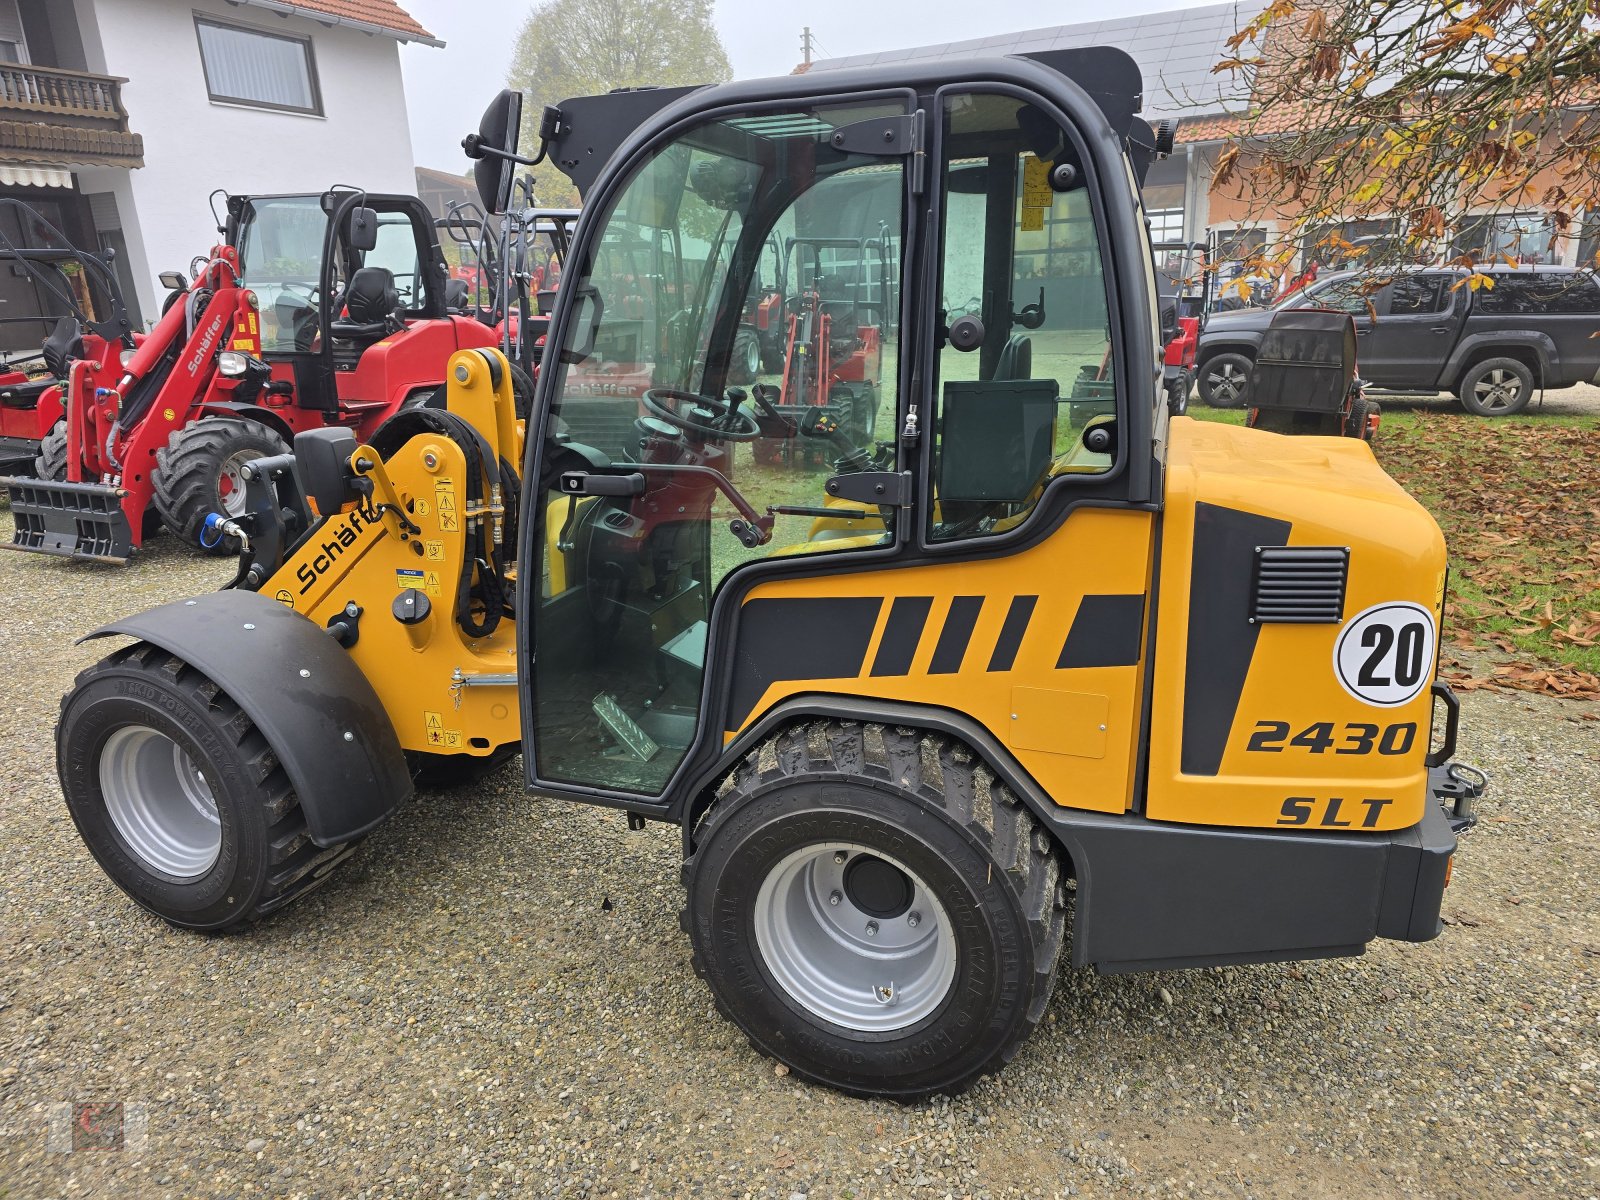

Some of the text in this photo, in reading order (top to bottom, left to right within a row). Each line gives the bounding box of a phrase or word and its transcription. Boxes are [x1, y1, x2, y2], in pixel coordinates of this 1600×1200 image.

[187, 314, 222, 378] Schäffer
[1357, 622, 1425, 687] 20
[1246, 720, 1418, 756] 2430
[1276, 796, 1394, 828] SLT
